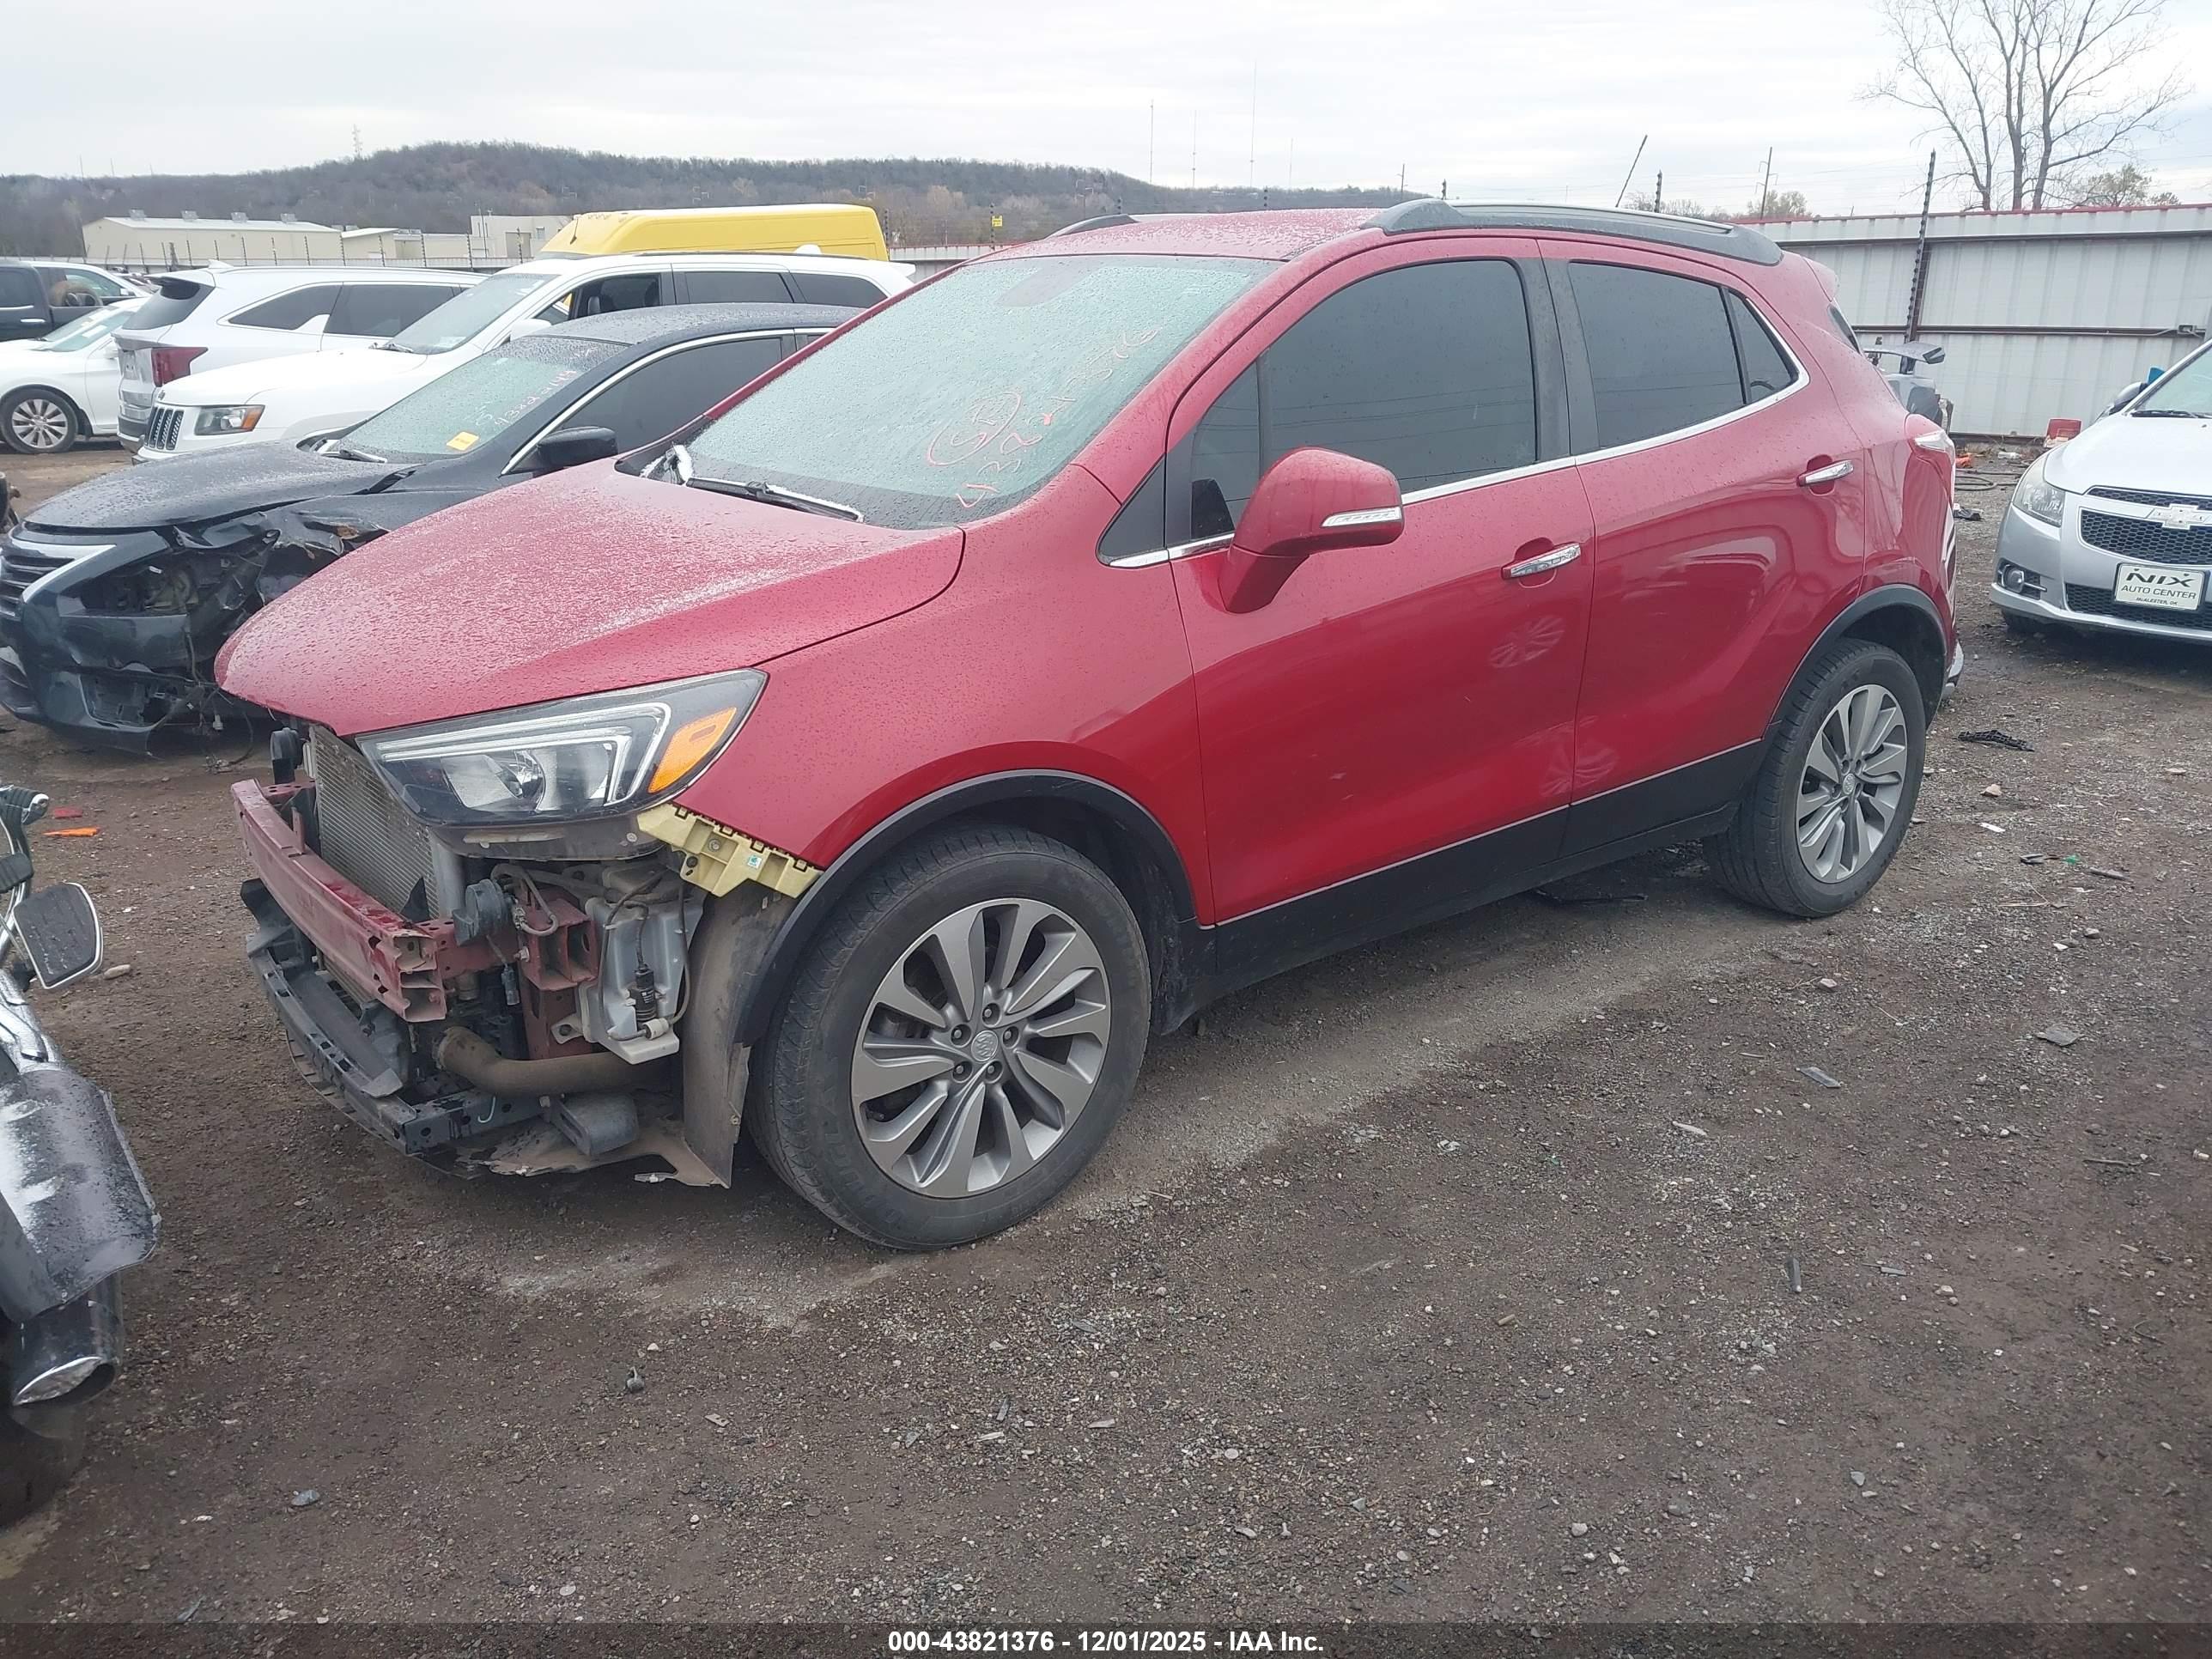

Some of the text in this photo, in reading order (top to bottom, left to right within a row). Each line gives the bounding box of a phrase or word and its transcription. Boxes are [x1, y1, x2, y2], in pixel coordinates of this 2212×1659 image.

[2126, 573, 2195, 587] NIX
[2122, 586, 2197, 599] AUTO CENTER
